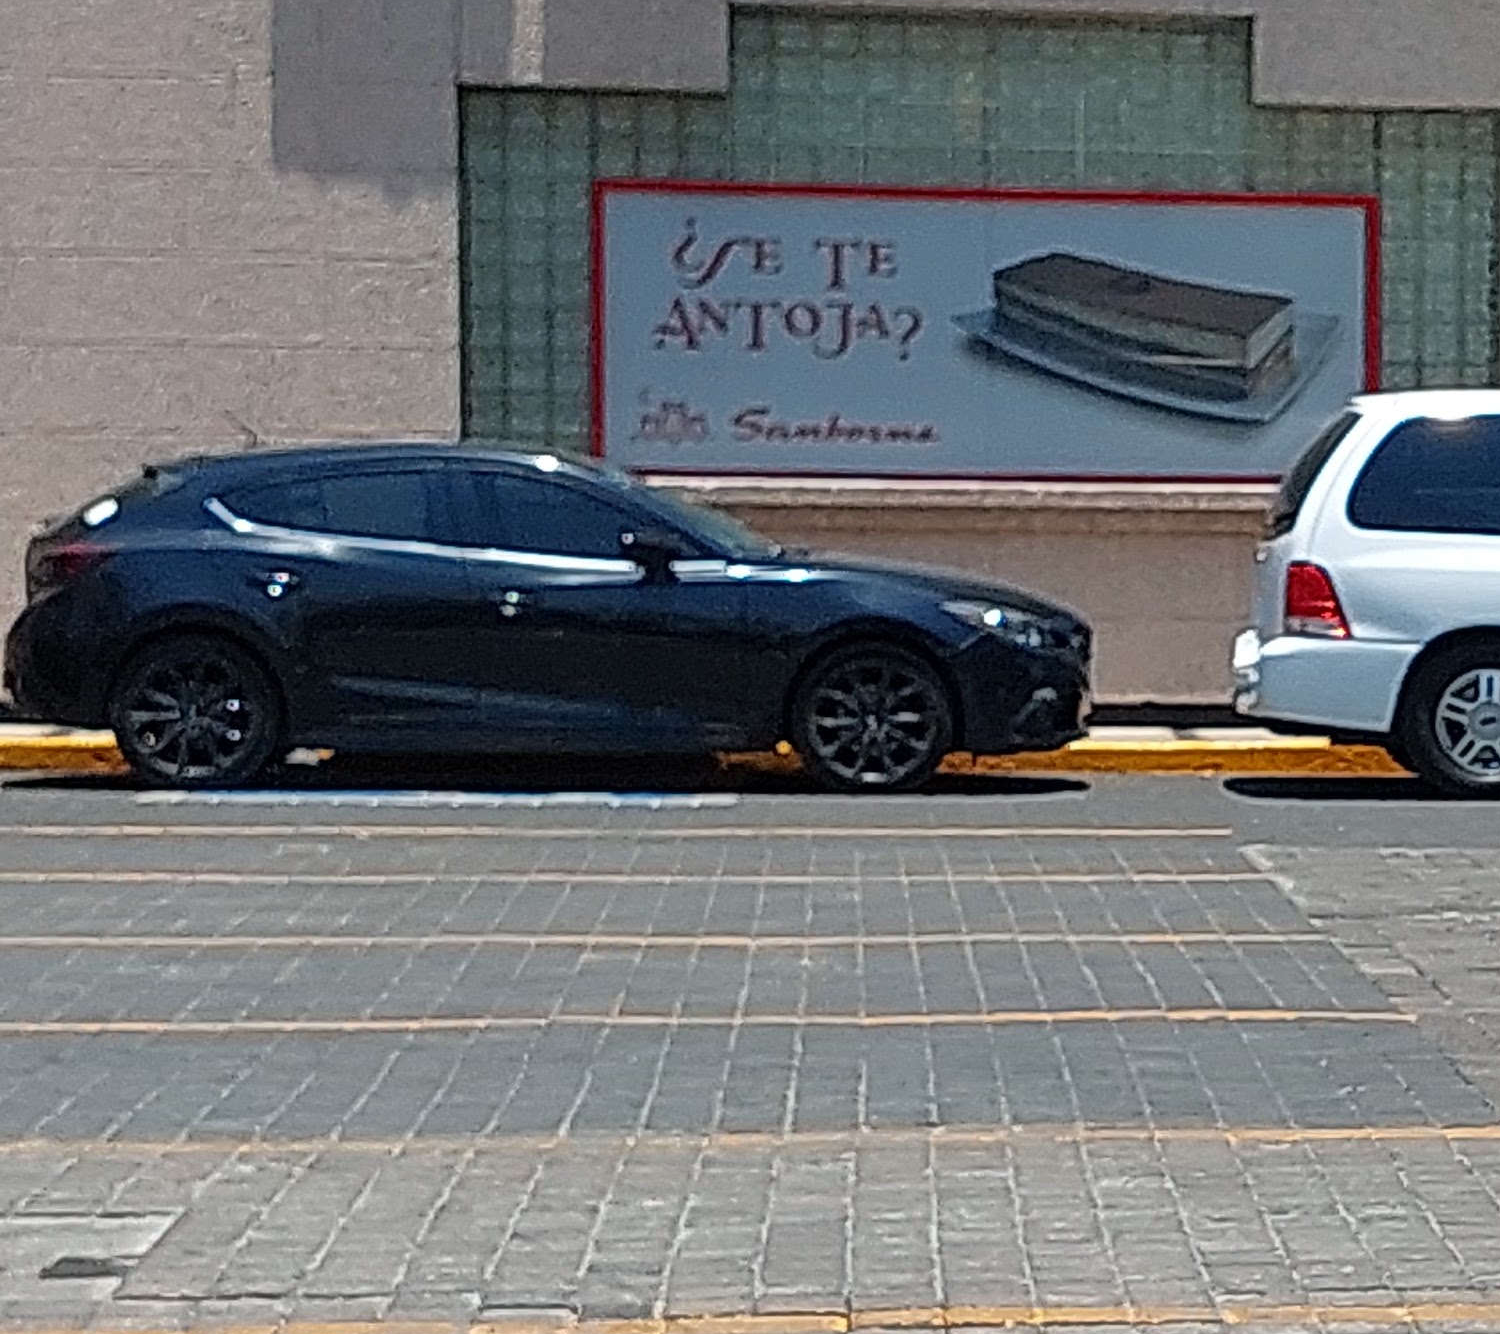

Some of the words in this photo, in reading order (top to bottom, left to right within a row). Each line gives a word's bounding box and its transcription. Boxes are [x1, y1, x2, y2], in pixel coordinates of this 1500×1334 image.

[813, 236, 898, 291] TE
[652, 297, 924, 361] ANTOJA?
[731, 405, 942, 443] Sanborns
